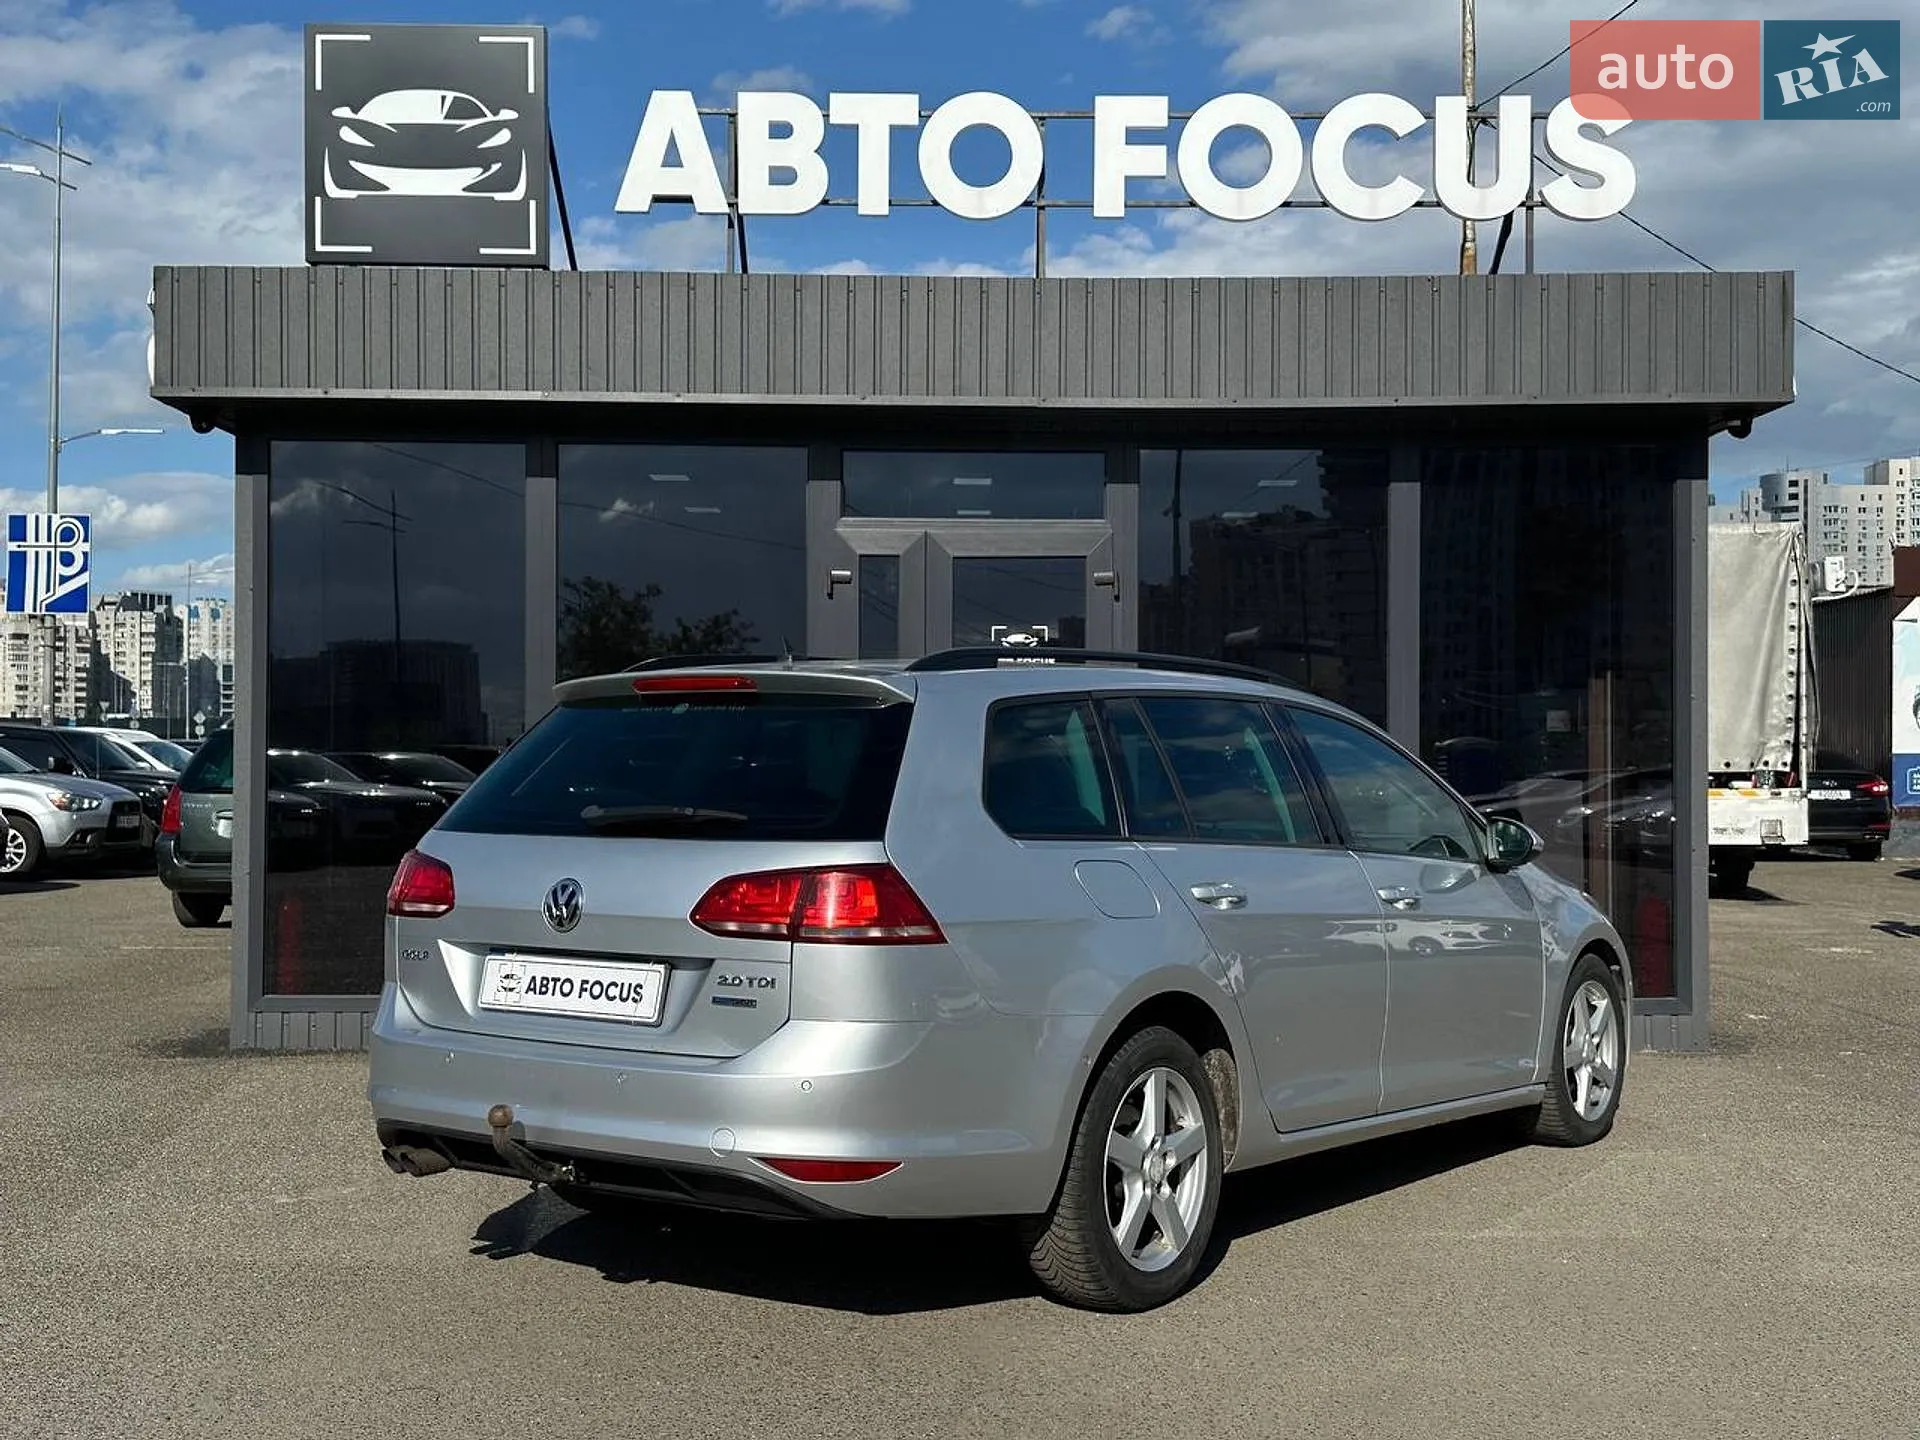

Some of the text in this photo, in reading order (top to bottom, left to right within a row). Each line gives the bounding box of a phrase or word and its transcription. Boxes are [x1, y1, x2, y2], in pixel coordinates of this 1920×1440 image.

[614, 89, 1637, 221] АВТО FOCUS
[525, 975, 643, 1004] АВТО FOCUS
[745, 976, 777, 989] TDI
